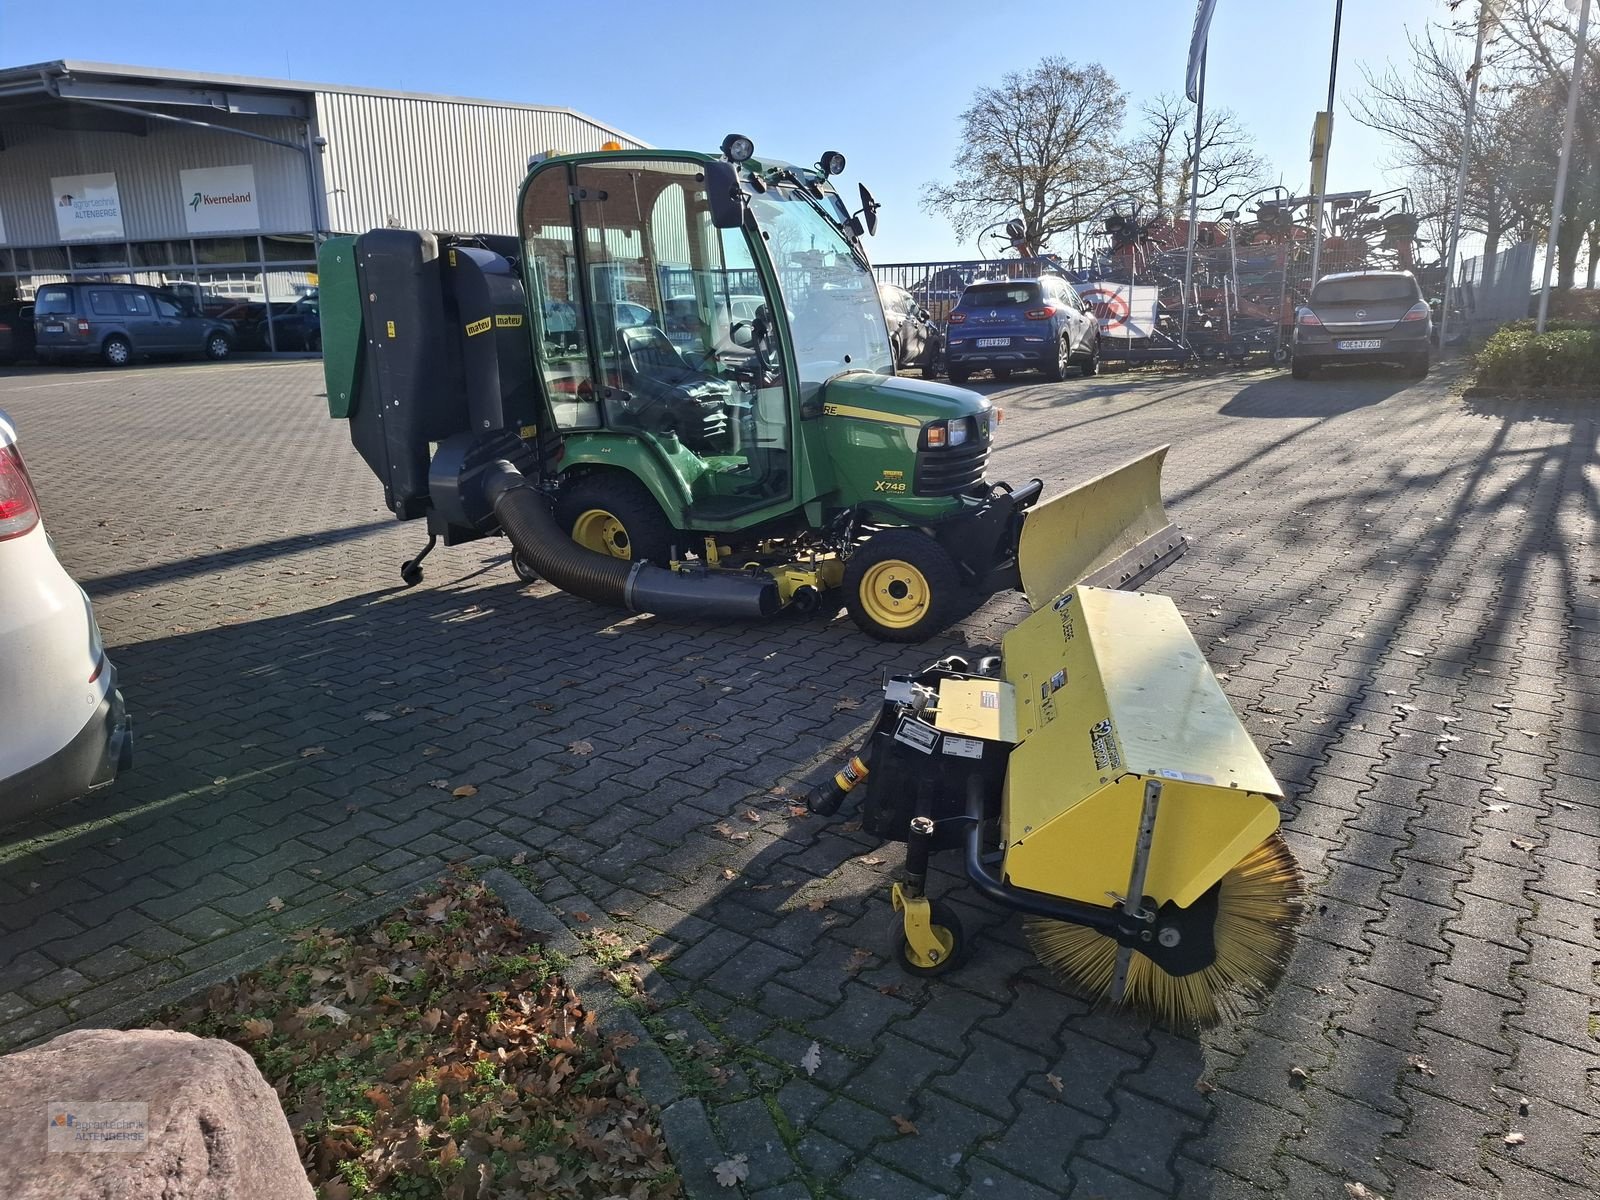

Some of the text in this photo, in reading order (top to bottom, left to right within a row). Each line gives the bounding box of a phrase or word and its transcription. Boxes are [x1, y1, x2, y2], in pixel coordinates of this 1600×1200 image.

[203, 192, 251, 206] Kverneland
[75, 209, 118, 220] ALTENBERGE
[874, 480, 906, 492] X748
[1091, 737, 1110, 771] BROOM
